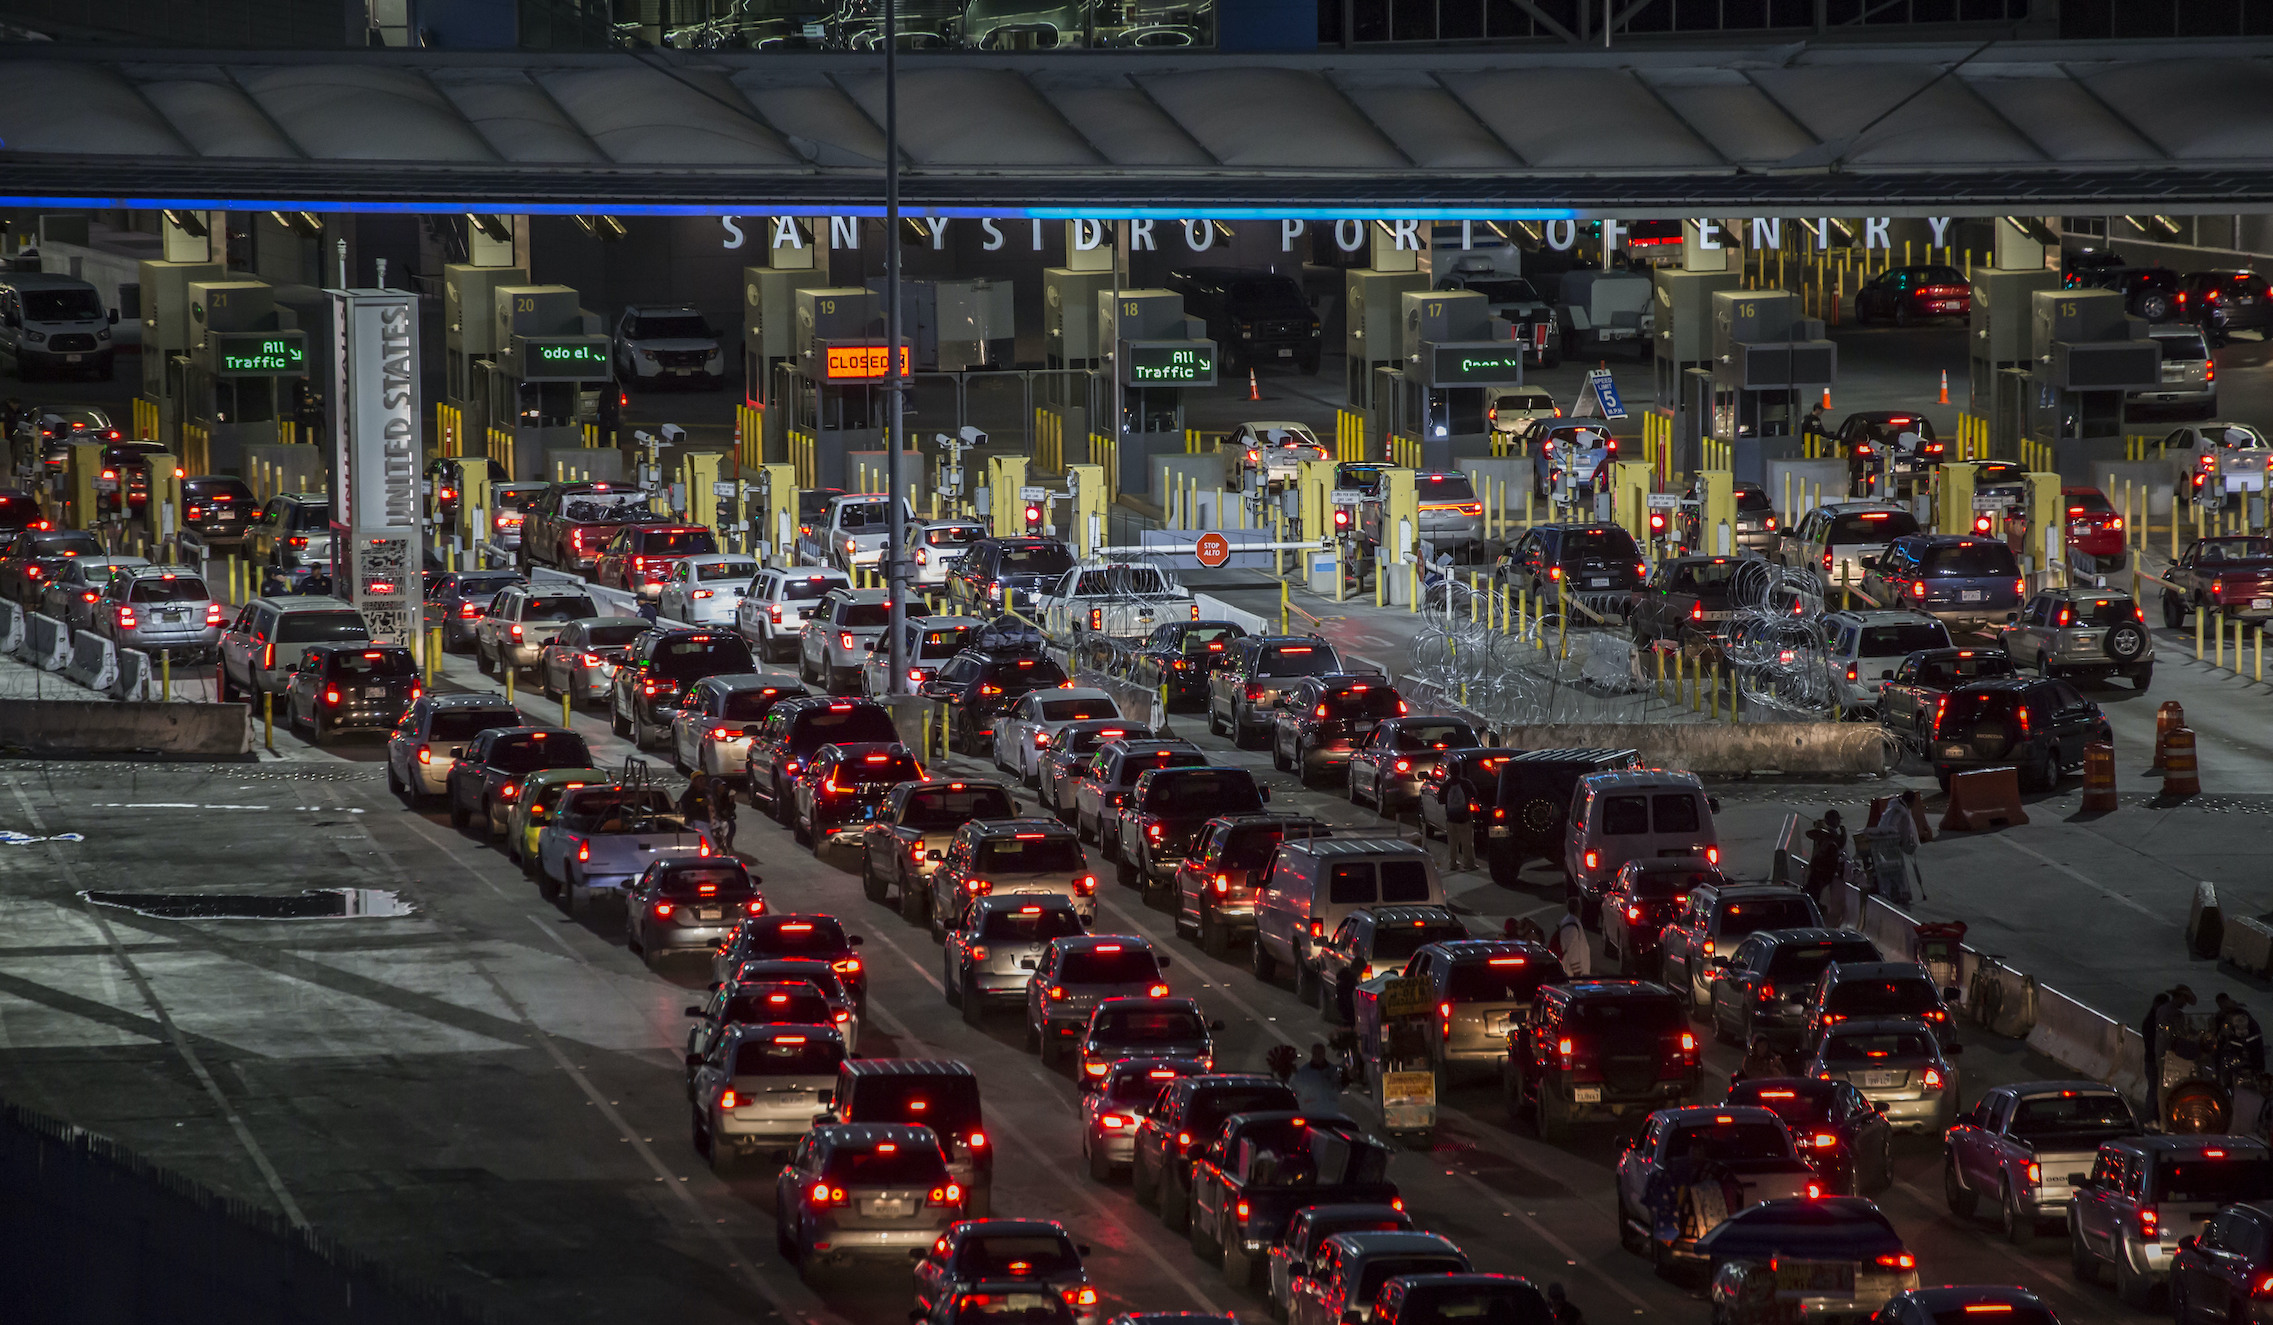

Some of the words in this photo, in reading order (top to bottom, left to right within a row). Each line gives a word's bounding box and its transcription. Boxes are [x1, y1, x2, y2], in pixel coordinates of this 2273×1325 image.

[722, 216, 860, 249] SAN
[926, 217, 1214, 251] YSIDRO
[1546, 219, 1628, 250] OF
[212, 293, 228, 308] 21
[517, 298, 535, 313] 20
[820, 300, 836, 315] 19
[1123, 302, 1139, 317] 18
[1428, 303, 1443, 317] 17
[1739, 303, 1756, 318] 16
[2061, 302, 2077, 317] 15
[262, 341, 285, 354] All
[225, 356, 286, 369] Traffic
[381, 305, 412, 411] STATES
[829, 356, 889, 369] CLOSED
[1173, 350, 1194, 364] All
[1135, 365, 1194, 379] Traffic
[1593, 377, 1613, 385] SPEED
[1603, 390, 1617, 408] 5
[384, 417, 413, 527] UNITED
[1203, 549, 1221, 557] ALTO
